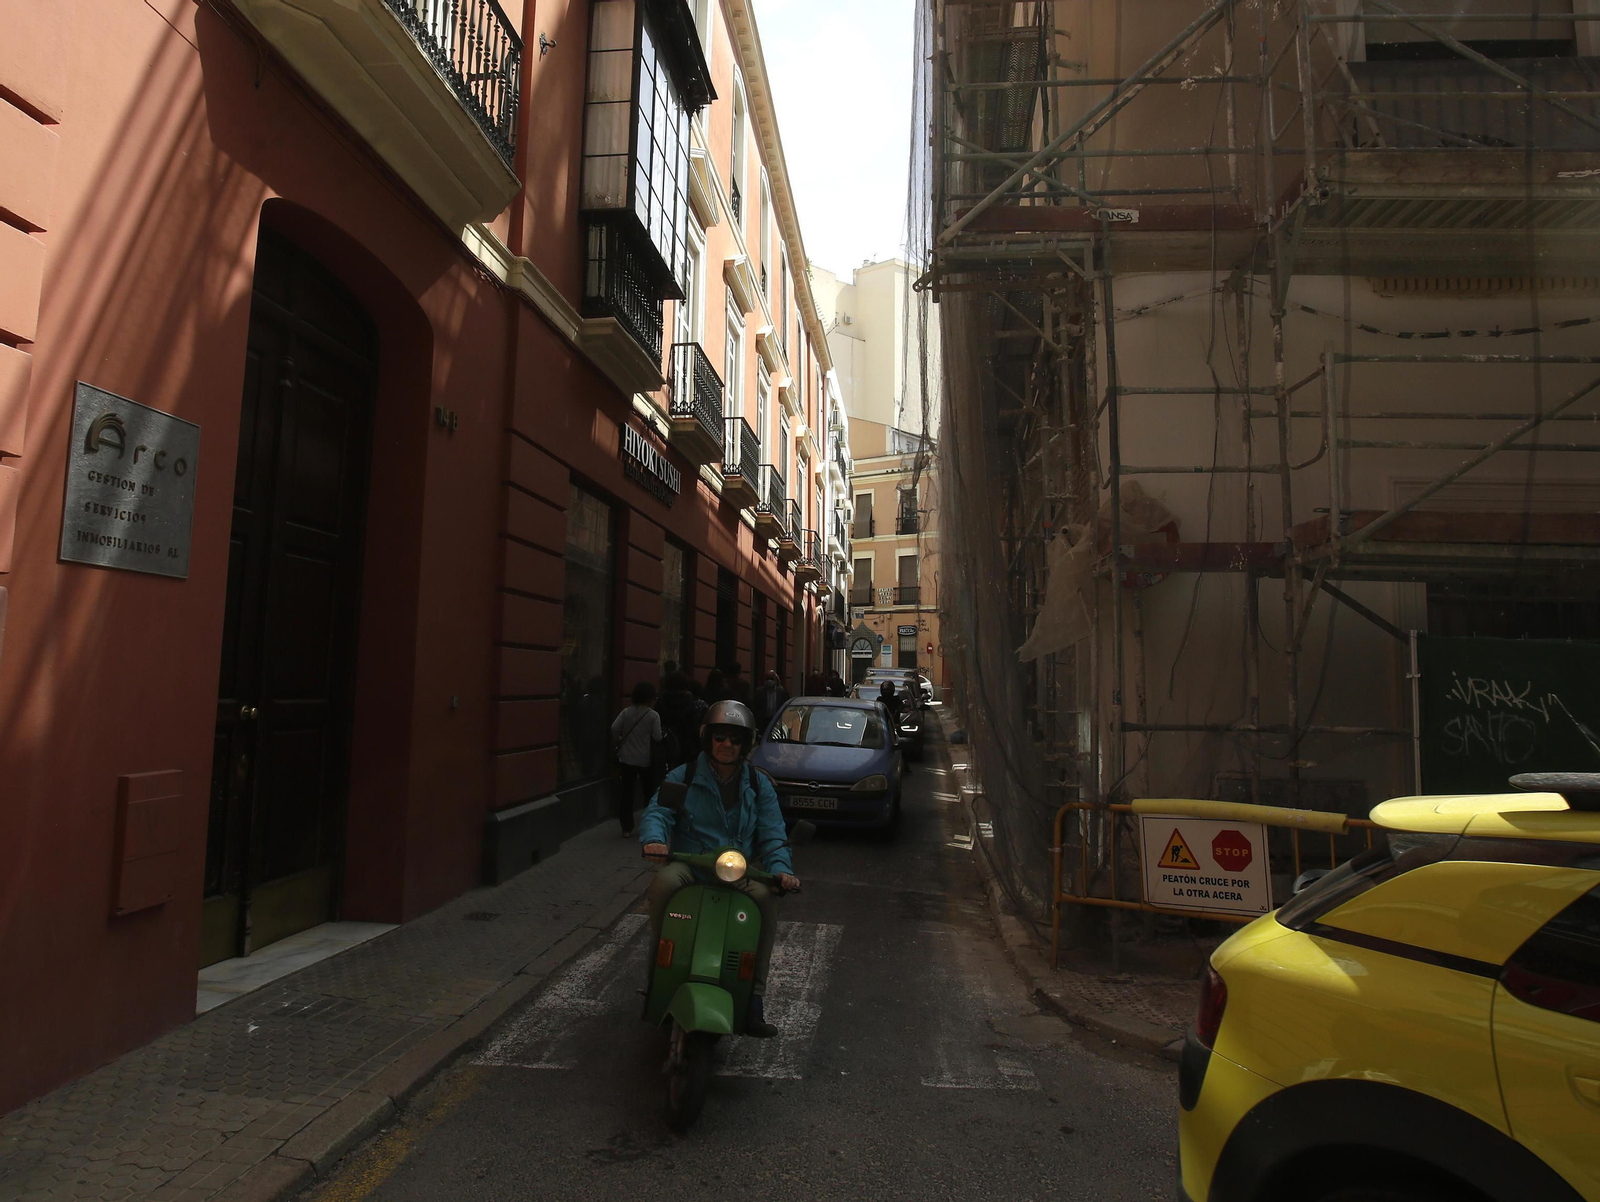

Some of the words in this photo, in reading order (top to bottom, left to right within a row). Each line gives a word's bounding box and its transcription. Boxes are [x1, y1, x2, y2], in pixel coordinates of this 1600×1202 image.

[623, 422, 659, 476] HIYOKI
[659, 455, 681, 495] SUSHI
[87, 470, 136, 492] GESTION
[141, 484, 155, 496] DE
[84, 501, 146, 524] SERVICIOS
[76, 530, 161, 554] INMOBILIARIOS
[792, 797, 815, 807] 8555
[817, 799, 835, 808] CCH
[1215, 847, 1249, 857] STOP
[1162, 874, 1196, 884] PEATÓN
[1199, 877, 1229, 887] CRUCE
[1231, 879, 1250, 888] POR
[1173, 888, 1184, 896] LA
[1186, 889, 1210, 898] OTRA
[1212, 891, 1243, 901] ACERA
[669, 912, 692, 920] vespa
